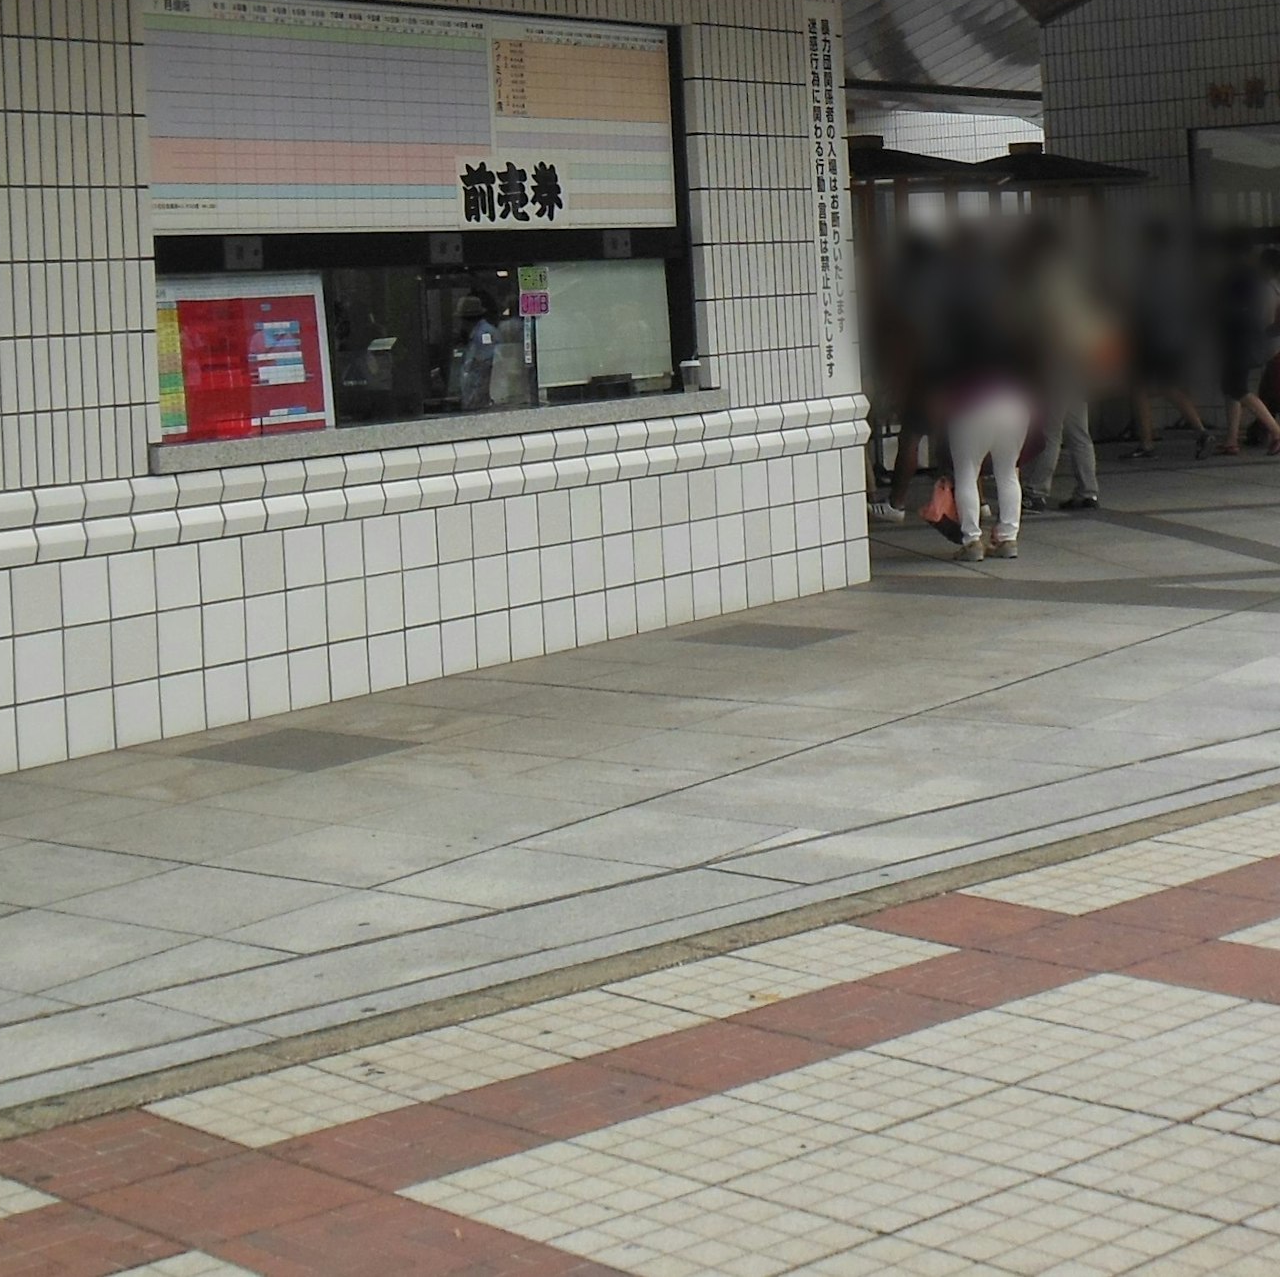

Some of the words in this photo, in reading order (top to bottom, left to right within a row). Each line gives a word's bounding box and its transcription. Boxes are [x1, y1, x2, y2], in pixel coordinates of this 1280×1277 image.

[461, 161, 564, 222] 前売券
[522, 294, 549, 314] JTB
